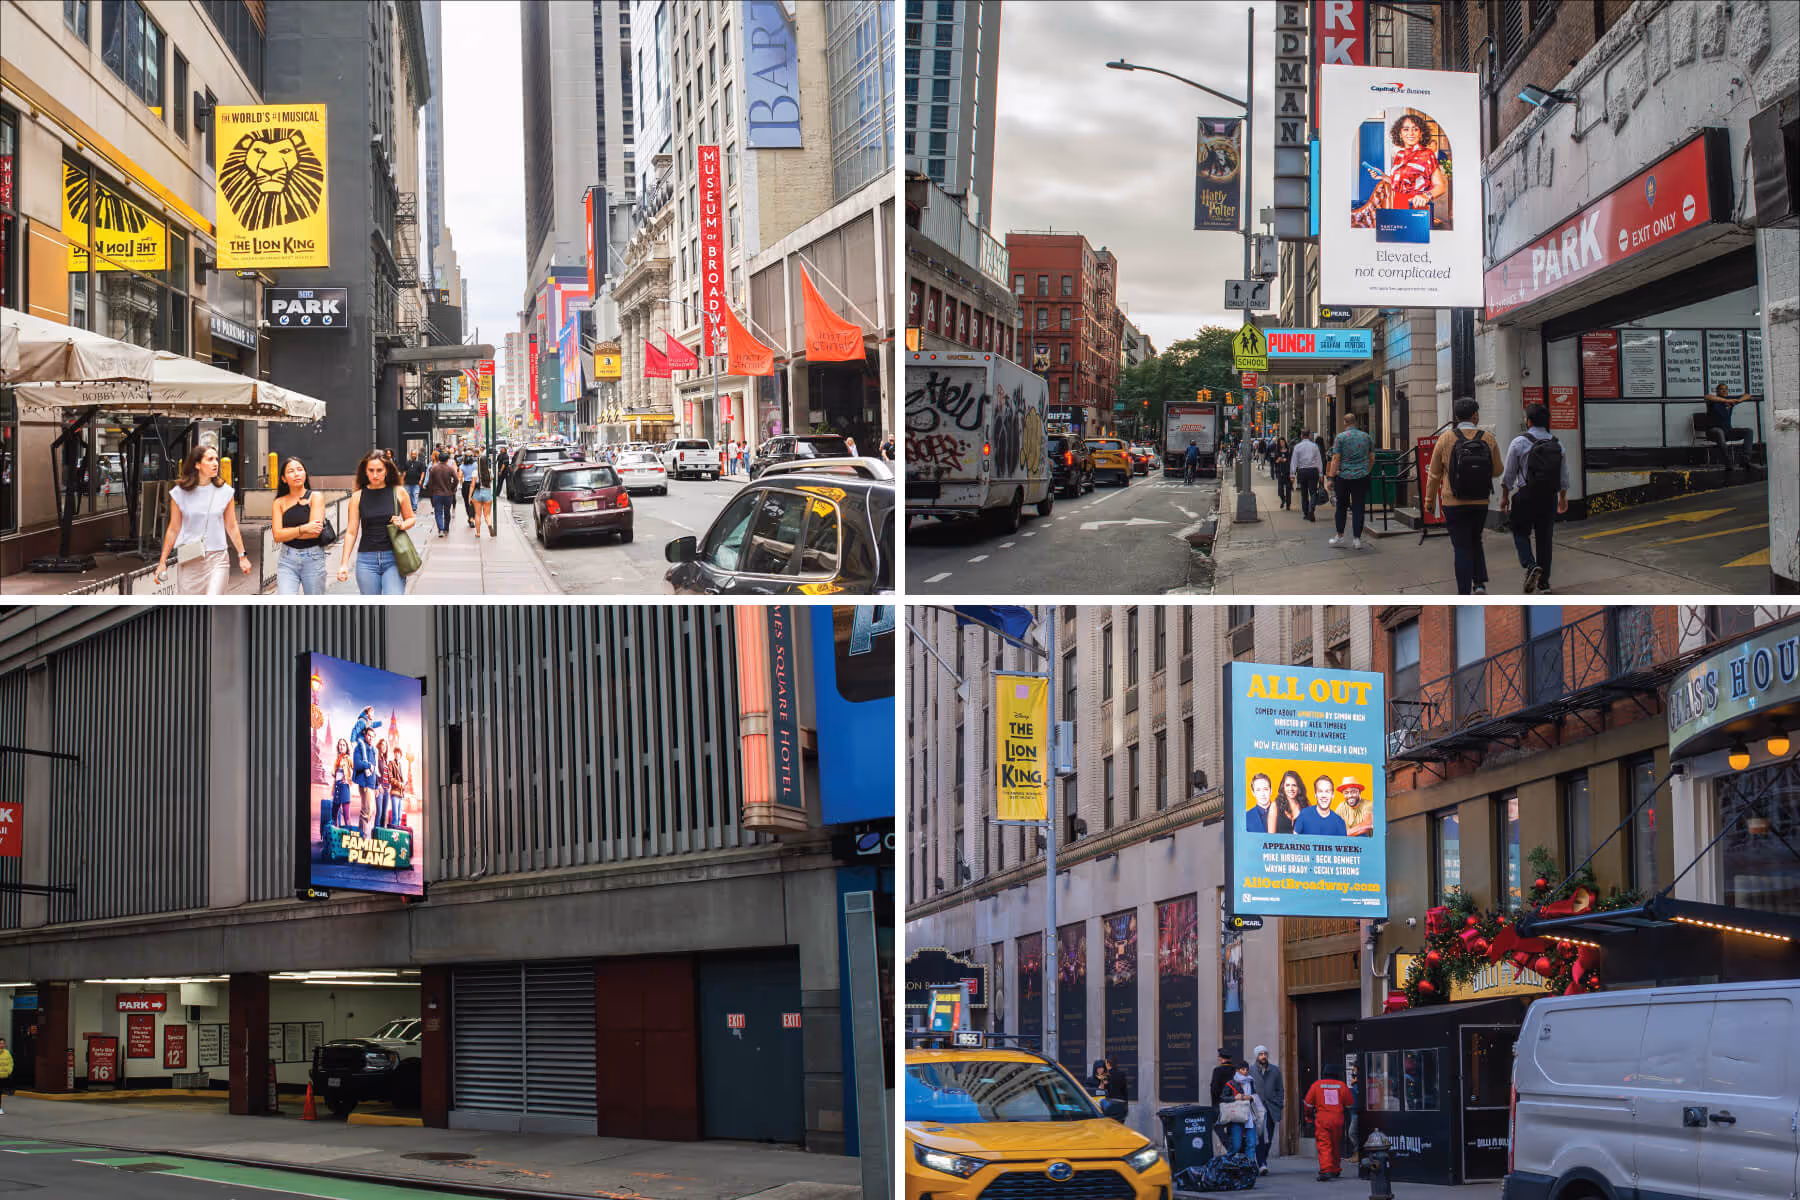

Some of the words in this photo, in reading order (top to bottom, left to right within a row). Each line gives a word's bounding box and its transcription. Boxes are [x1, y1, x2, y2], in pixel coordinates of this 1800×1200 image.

[1279, 4, 1301, 143] EDMAN
[221, 113, 231, 122] THE
[231, 112, 271, 124] WORLD'S
[282, 111, 320, 123] MUSICAL
[703, 151, 718, 228] MUSEUM
[1200, 188, 1228, 206] Harry
[1208, 199, 1236, 217] Potter
[1632, 224, 1651, 247] EXIT
[1653, 211, 1677, 237] ONLY
[229, 240, 251, 251] THE
[253, 237, 281, 255] LION
[283, 236, 315, 255] KING
[1532, 210, 1602, 291] PARK
[1376, 250, 1432, 264] Elevated,
[1355, 267, 1374, 278] not
[1377, 266, 1451, 280] complicated
[271, 299, 341, 314] PARK
[1267, 333, 1316, 353] PUNCH
[1237, 358, 1265, 367] SCHOOL
[82, 392, 115, 401] BOBBY
[1047, 412, 1072, 420] GIFTS
[775, 644, 788, 722] SQUARE
[1247, 674, 1305, 701] ALL
[1309, 678, 1372, 706] OUT
[1255, 707, 1277, 716] COMEDY
[1278, 709, 1296, 717] ABOUT
[1009, 722, 1033, 735] THE
[1309, 720, 1322, 729] ALEX
[1323, 721, 1347, 730] TIMBERS
[1275, 728, 1290, 736] WITH
[1291, 729, 1308, 737] MUSIC
[1309, 730, 1317, 738] BY
[1318, 731, 1346, 740] LAWRENCE
[1005, 739, 1037, 762] LION
[1254, 740, 1270, 750] NOW
[1271, 741, 1299, 752] PLAYING
[1301, 743, 1317, 753] THRU
[1318, 744, 1342, 754] MARCH
[1348, 746, 1368, 756] ONLY!
[779, 729, 792, 796] HOTEL
[1001, 763, 1042, 789] KING
[341, 834, 389, 853] FAMILY
[1262, 842, 1311, 852] APPEARING
[1312, 844, 1333, 852] THIS
[1334, 845, 1363, 854] WEEK:
[348, 849, 385, 867] PLAN
[383, 846, 397, 868] 2
[1262, 853, 1279, 862] MIKE
[1315, 855, 1332, 864] BECK
[1333, 856, 1361, 865] BENNETT
[1264, 863, 1287, 874] WAYNE
[1287, 865, 1308, 875] BRADY
[1335, 866, 1360, 876] STRONG
[1243, 876, 1381, 894] AllOutBroadway.com
[119, 1001, 149, 1009] PARK
[728, 1014, 744, 1026] EXIT
[783, 1014, 799, 1026] EXIT
[168, 1050, 180, 1065] 12
[92, 1065, 109, 1080] 16
